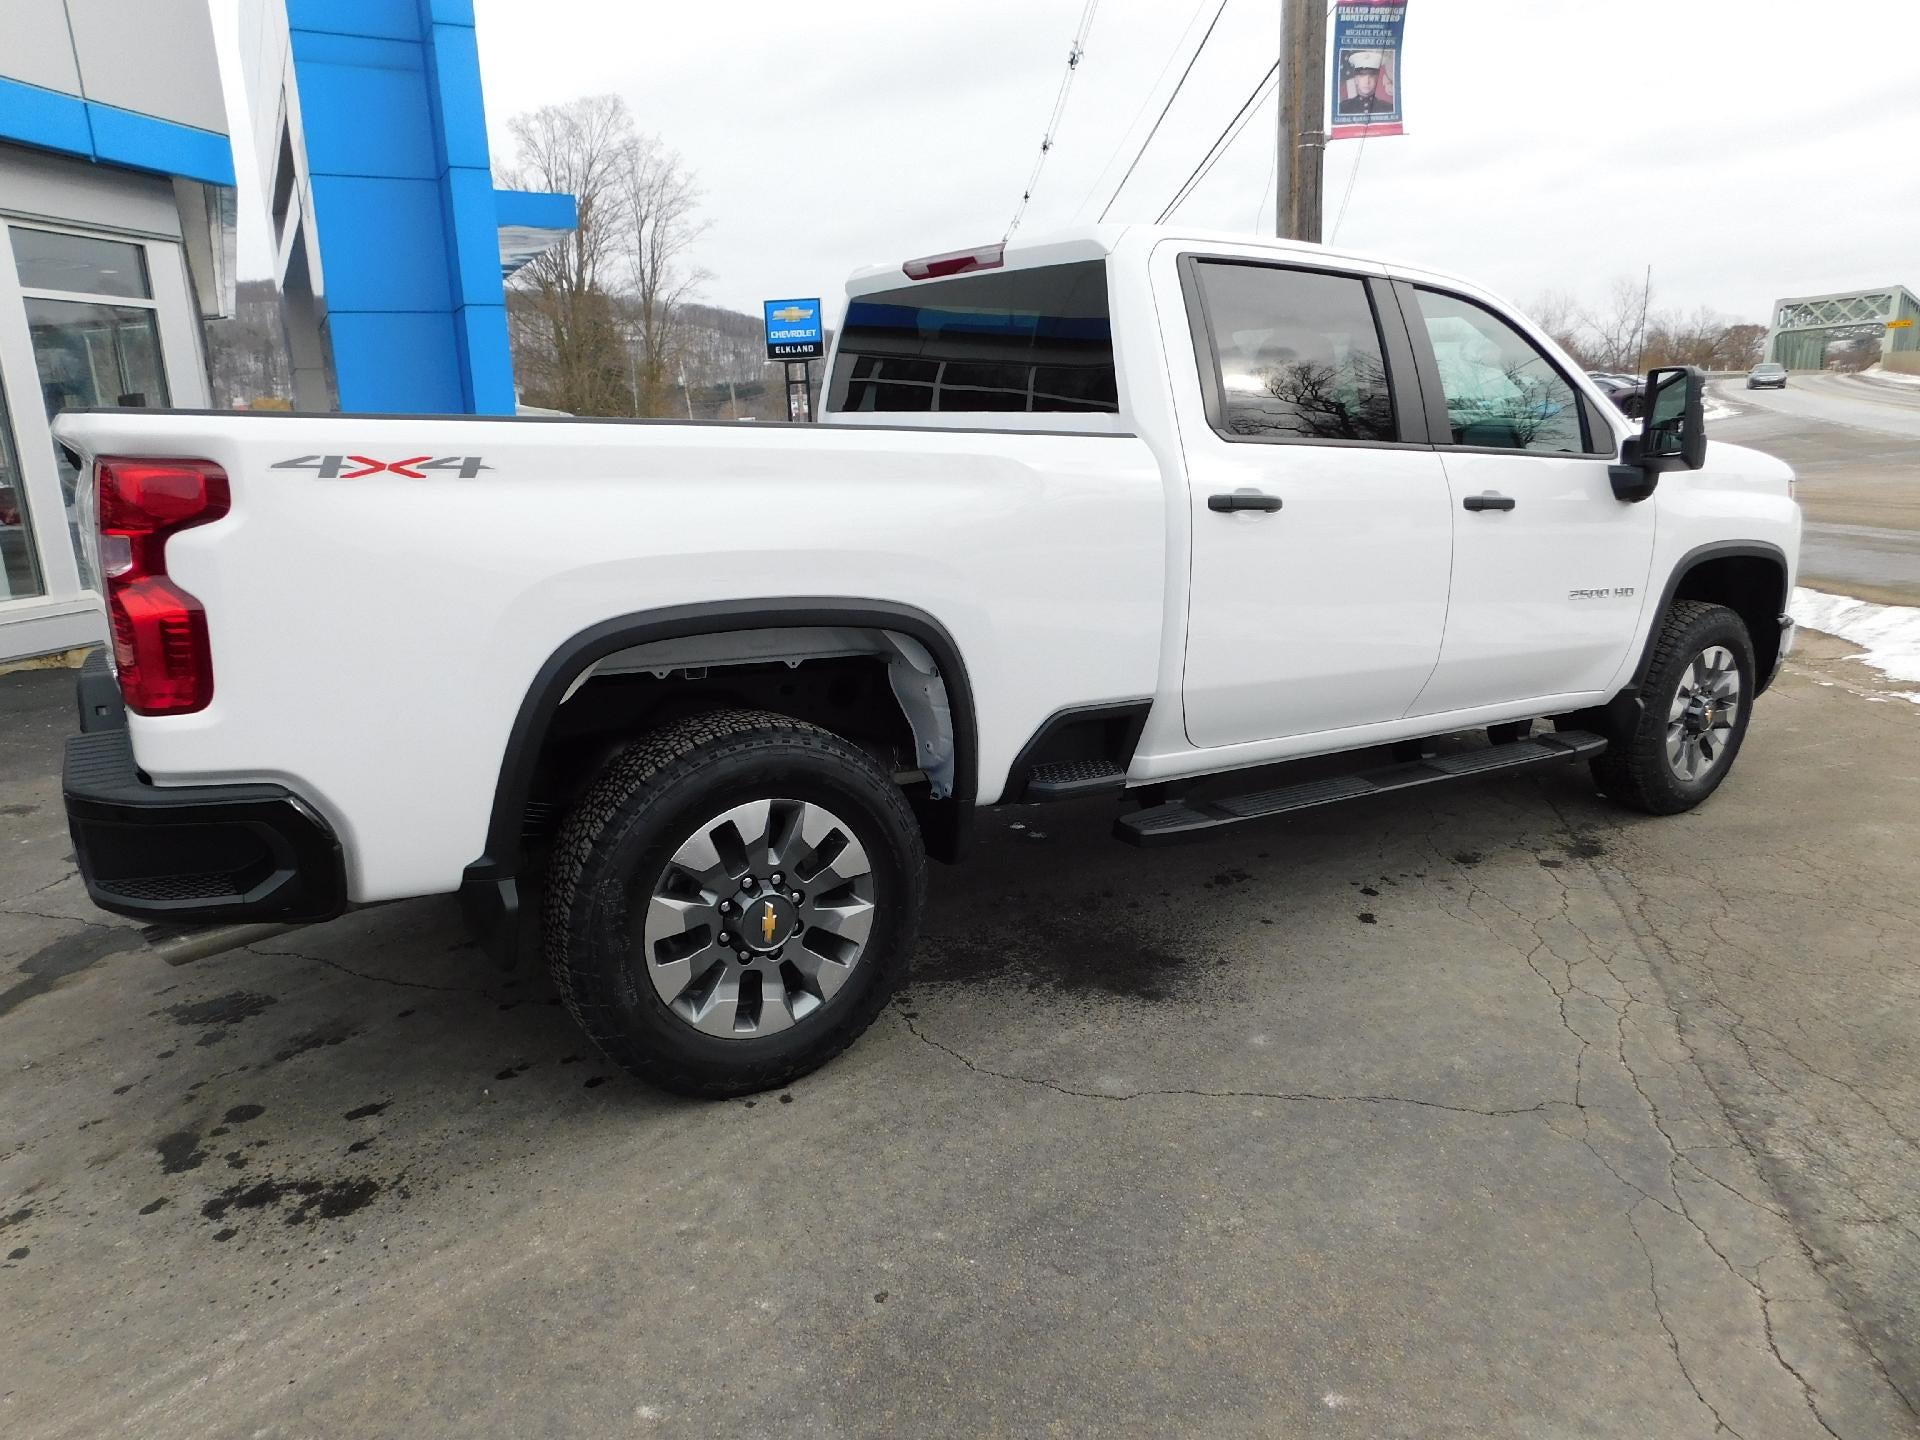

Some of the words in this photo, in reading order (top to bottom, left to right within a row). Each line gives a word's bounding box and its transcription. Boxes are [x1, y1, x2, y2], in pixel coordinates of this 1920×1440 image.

[1340, 14, 1379, 22] HOMETOWN
[1380, 14, 1400, 22] HERO
[770, 329, 816, 339] CHEVROLET
[775, 345, 814, 354] ELKLAND
[1568, 588, 1609, 600] 2500
[1614, 587, 1634, 598] HD
